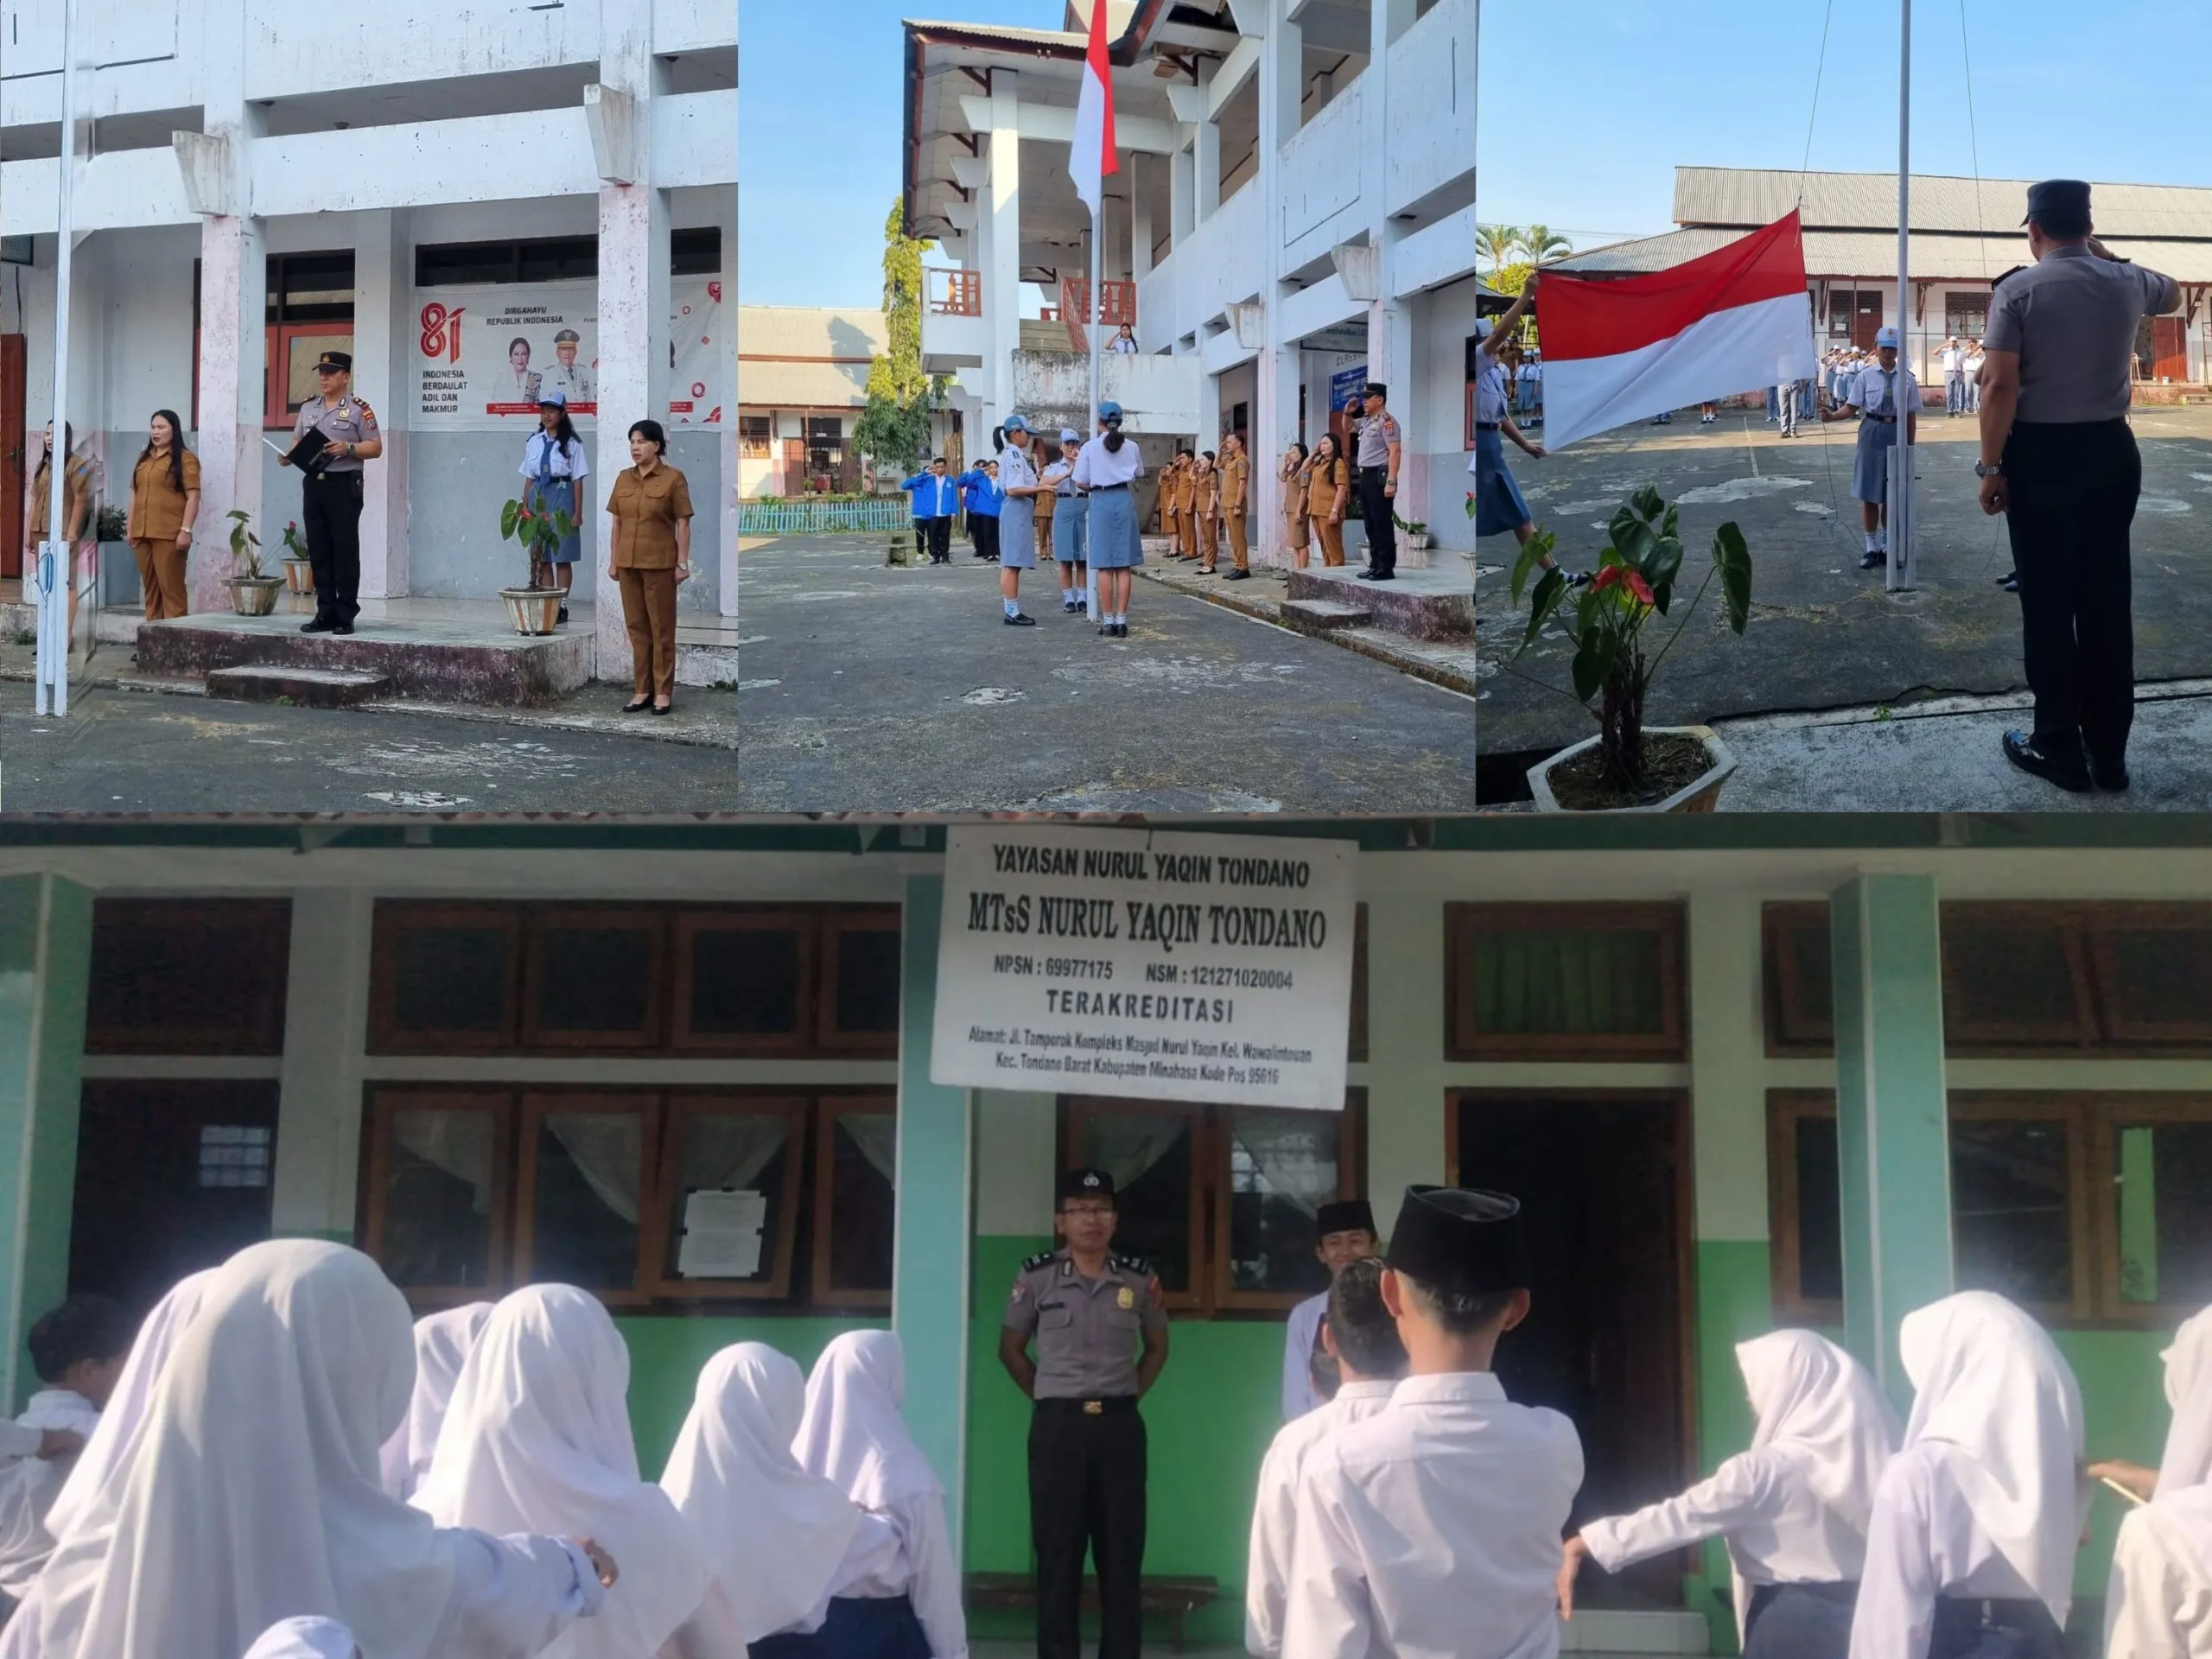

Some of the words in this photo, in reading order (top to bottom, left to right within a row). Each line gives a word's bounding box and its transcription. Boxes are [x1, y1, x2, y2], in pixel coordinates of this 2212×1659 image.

[486, 317, 522, 326] REPUBLIK
[523, 315, 563, 324] INDONESIA
[504, 306, 547, 315] DIRGAHAYU
[422, 381, 468, 391] BERDAULAT
[423, 370, 465, 378] INDONESIA
[422, 393, 440, 402] ADIL
[442, 393, 458, 402] DAN
[422, 404, 458, 413] MAKMUR
[994, 843, 1078, 877] YAYASAN
[1084, 849, 1148, 880] NURUL
[1154, 854, 1211, 884] YAQIN
[1217, 856, 1310, 889] TONDANO
[968, 892, 1031, 933] MTsS
[1038, 896, 1118, 938] NURUL
[1127, 901, 1201, 953] YAQIN
[1209, 903, 1326, 950] TONDANO
[994, 954, 1033, 976] NPSN
[1046, 957, 1113, 980] 69977175
[1146, 963, 1179, 983] NSM
[1191, 965, 1294, 990] 121271020004
[1046, 988, 1234, 1024] TERAKREDITASI
[968, 1025, 1007, 1044] Alamat:
[1073, 1031, 1123, 1052] Kompleks
[1125, 1034, 1160, 1057] Masjid
[1161, 1037, 1189, 1056] Nurul
[1221, 1040, 1240, 1058] Kel.
[995, 1051, 1019, 1069] Kec.
[1020, 1052, 1062, 1071] Tondano
[1064, 1055, 1091, 1073] Barat
[1093, 1057, 1147, 1080] Kabupaten
[1148, 1060, 1198, 1080] Minahasa
[1199, 1064, 1225, 1083] Kode
[1228, 1065, 1246, 1084] Pos
